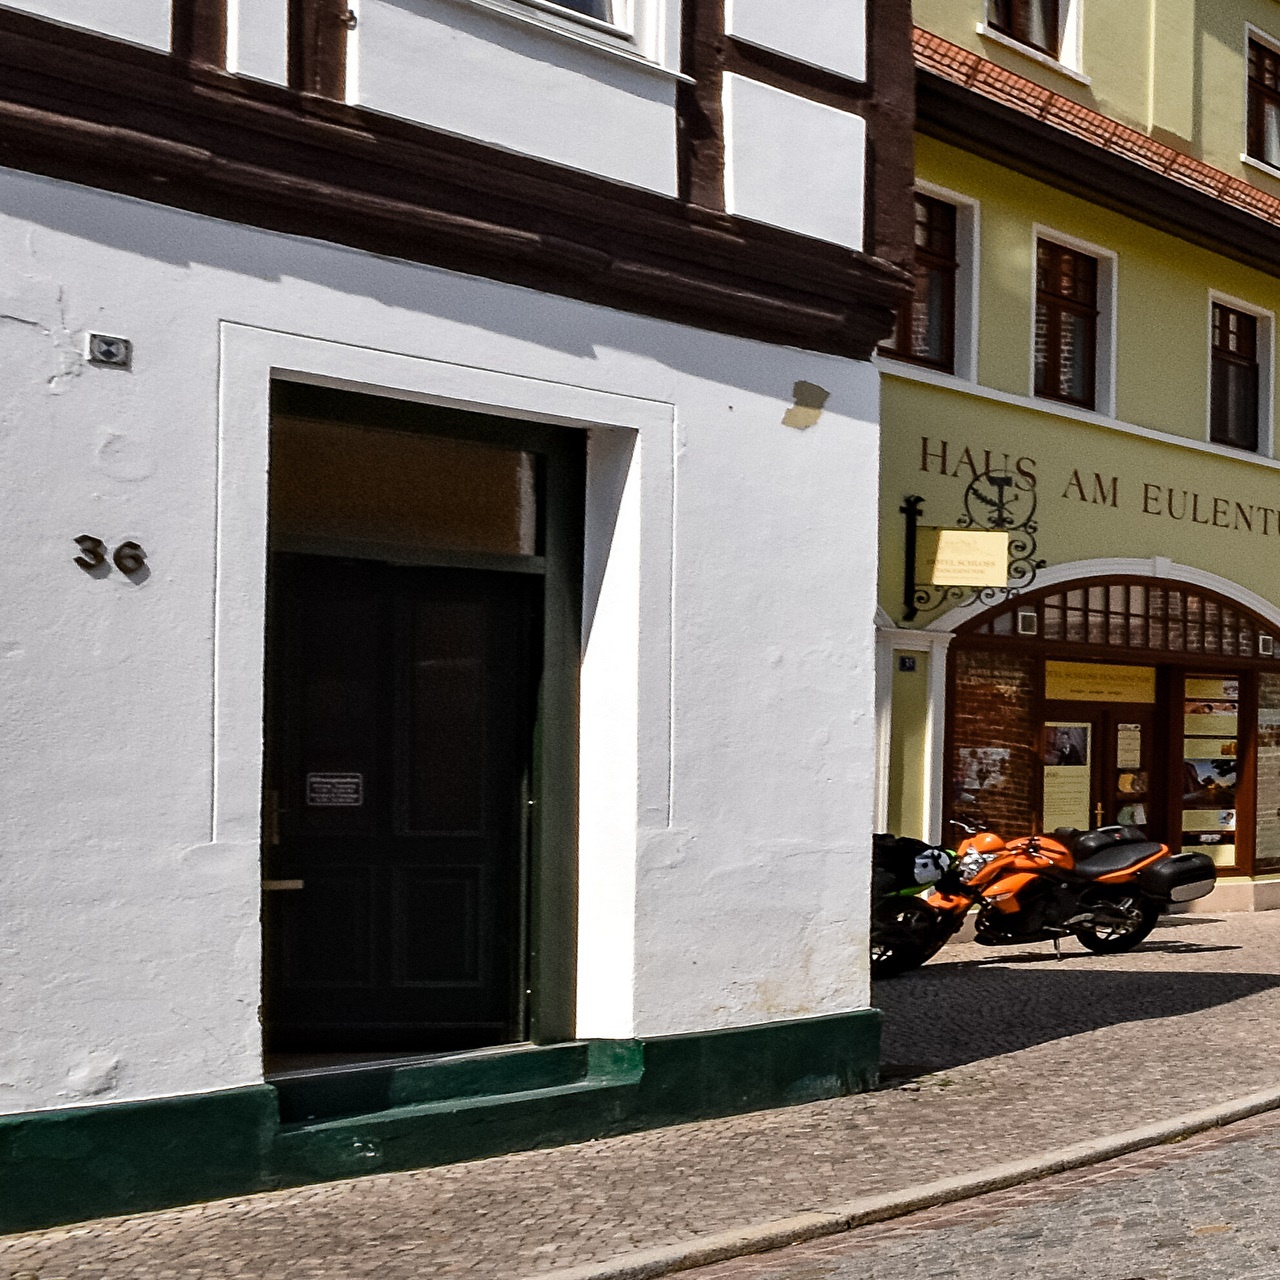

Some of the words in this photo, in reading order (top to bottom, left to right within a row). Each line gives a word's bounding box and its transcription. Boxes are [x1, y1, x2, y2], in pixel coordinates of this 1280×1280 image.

[920, 437, 1038, 492] HAUS
[1062, 468, 1119, 508] AM
[73, 534, 145, 575] 36
